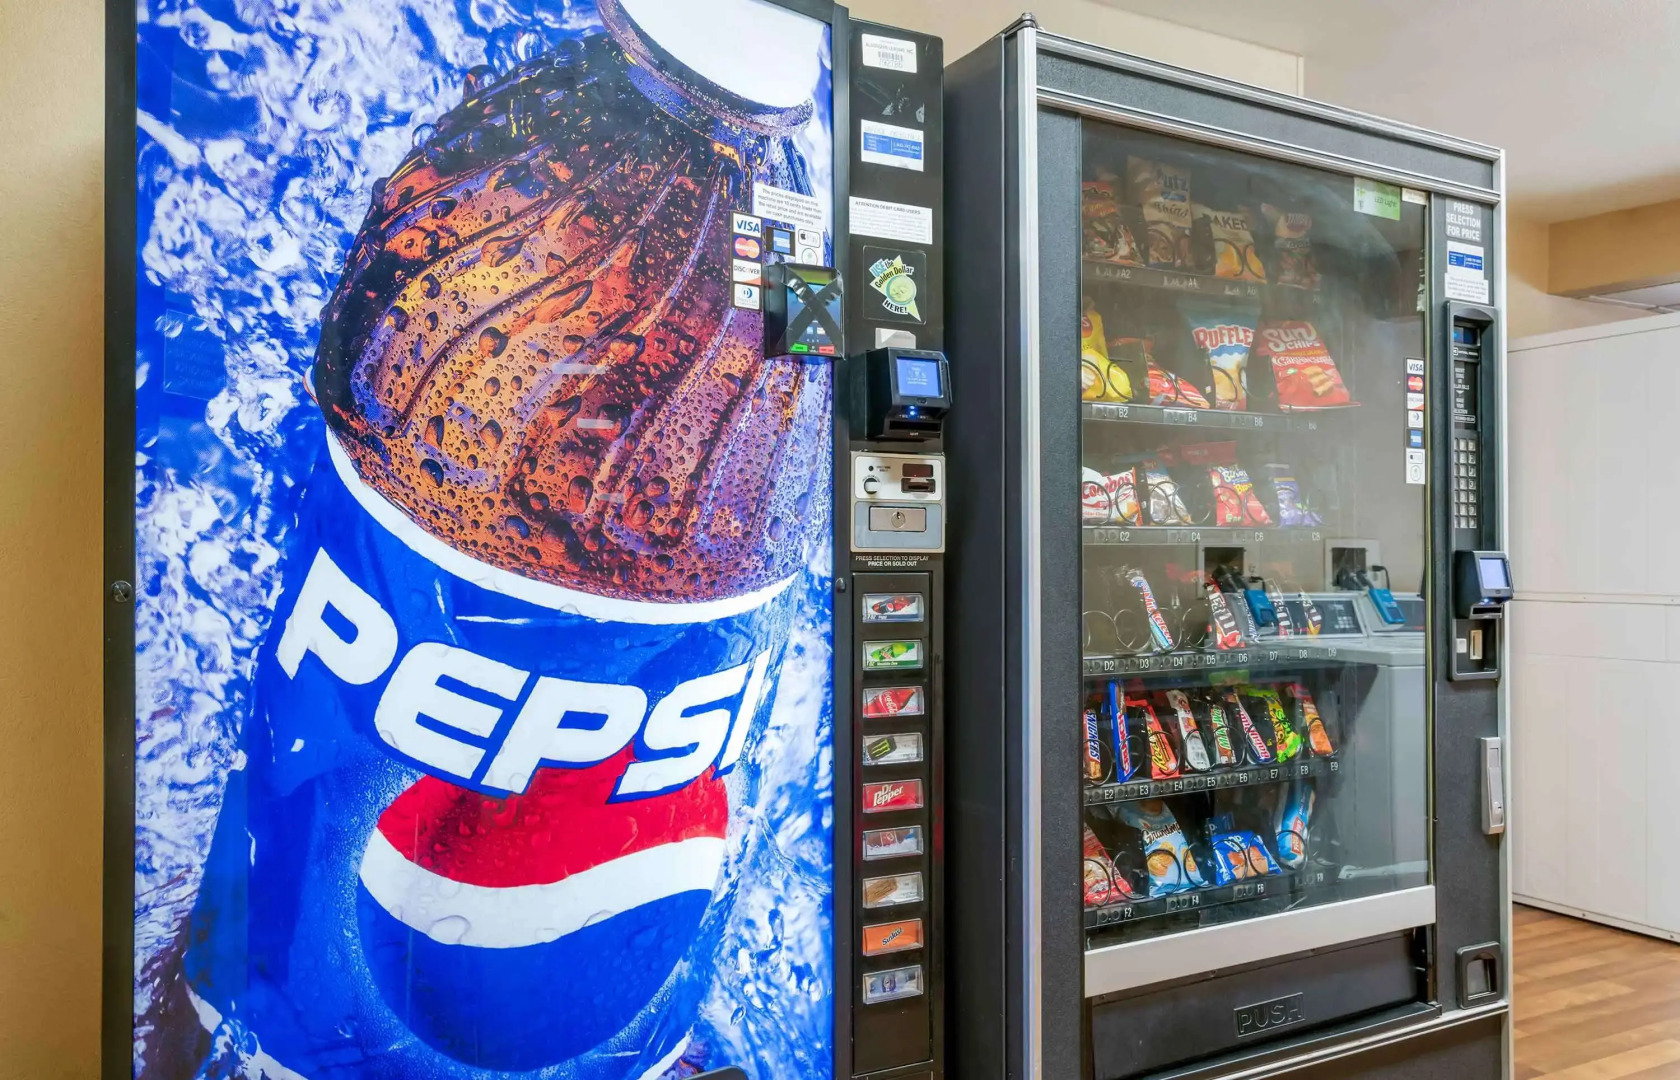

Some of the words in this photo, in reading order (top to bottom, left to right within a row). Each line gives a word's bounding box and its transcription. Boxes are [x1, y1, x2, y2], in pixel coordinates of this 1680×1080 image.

[1453, 202, 1474, 215] PRESS
[1446, 212, 1481, 228] SELECTION
[736, 220, 760, 233] VISA
[1447, 225, 1460, 236] FOR
[1461, 228, 1480, 240] PRICE
[734, 265, 760, 275] DISCOVER
[871, 260, 887, 277] USE
[875, 270, 893, 288] Golden
[893, 264, 913, 275] Dollar
[884, 300, 907, 313] HERE!
[1409, 363, 1424, 371] VISA
[1118, 408, 1129, 418] B2
[1188, 413, 1197, 422] B4
[1120, 532, 1130, 541] C2
[1192, 532, 1200, 541] C4
[1270, 652, 1278, 660] D7
[1299, 650, 1308, 658] D8
[1328, 648, 1337, 656] D9
[1174, 657, 1183, 666] D4
[1206, 655, 1215, 664] D5
[1238, 653, 1248, 662] D6
[1104, 661, 1114, 670] D2
[1140, 659, 1149, 668] D3
[276, 546, 772, 796] PEPSI
[1087, 711, 1100, 761] SNICKERS
[1300, 766, 1308, 774] E8
[1330, 762, 1338, 771] E9
[1240, 773, 1248, 782] E6
[1270, 769, 1278, 779] E7
[1207, 777, 1216, 786] E5
[882, 784, 893, 795] Dr
[1140, 786, 1149, 795] E3
[1174, 782, 1183, 791] E4
[873, 786, 903, 807] Pepper
[1104, 790, 1114, 799] E2
[1257, 884, 1264, 893] F6
[1192, 896, 1199, 904] F4
[1124, 908, 1132, 917] F2
[1240, 1000, 1302, 1033] PUSH
